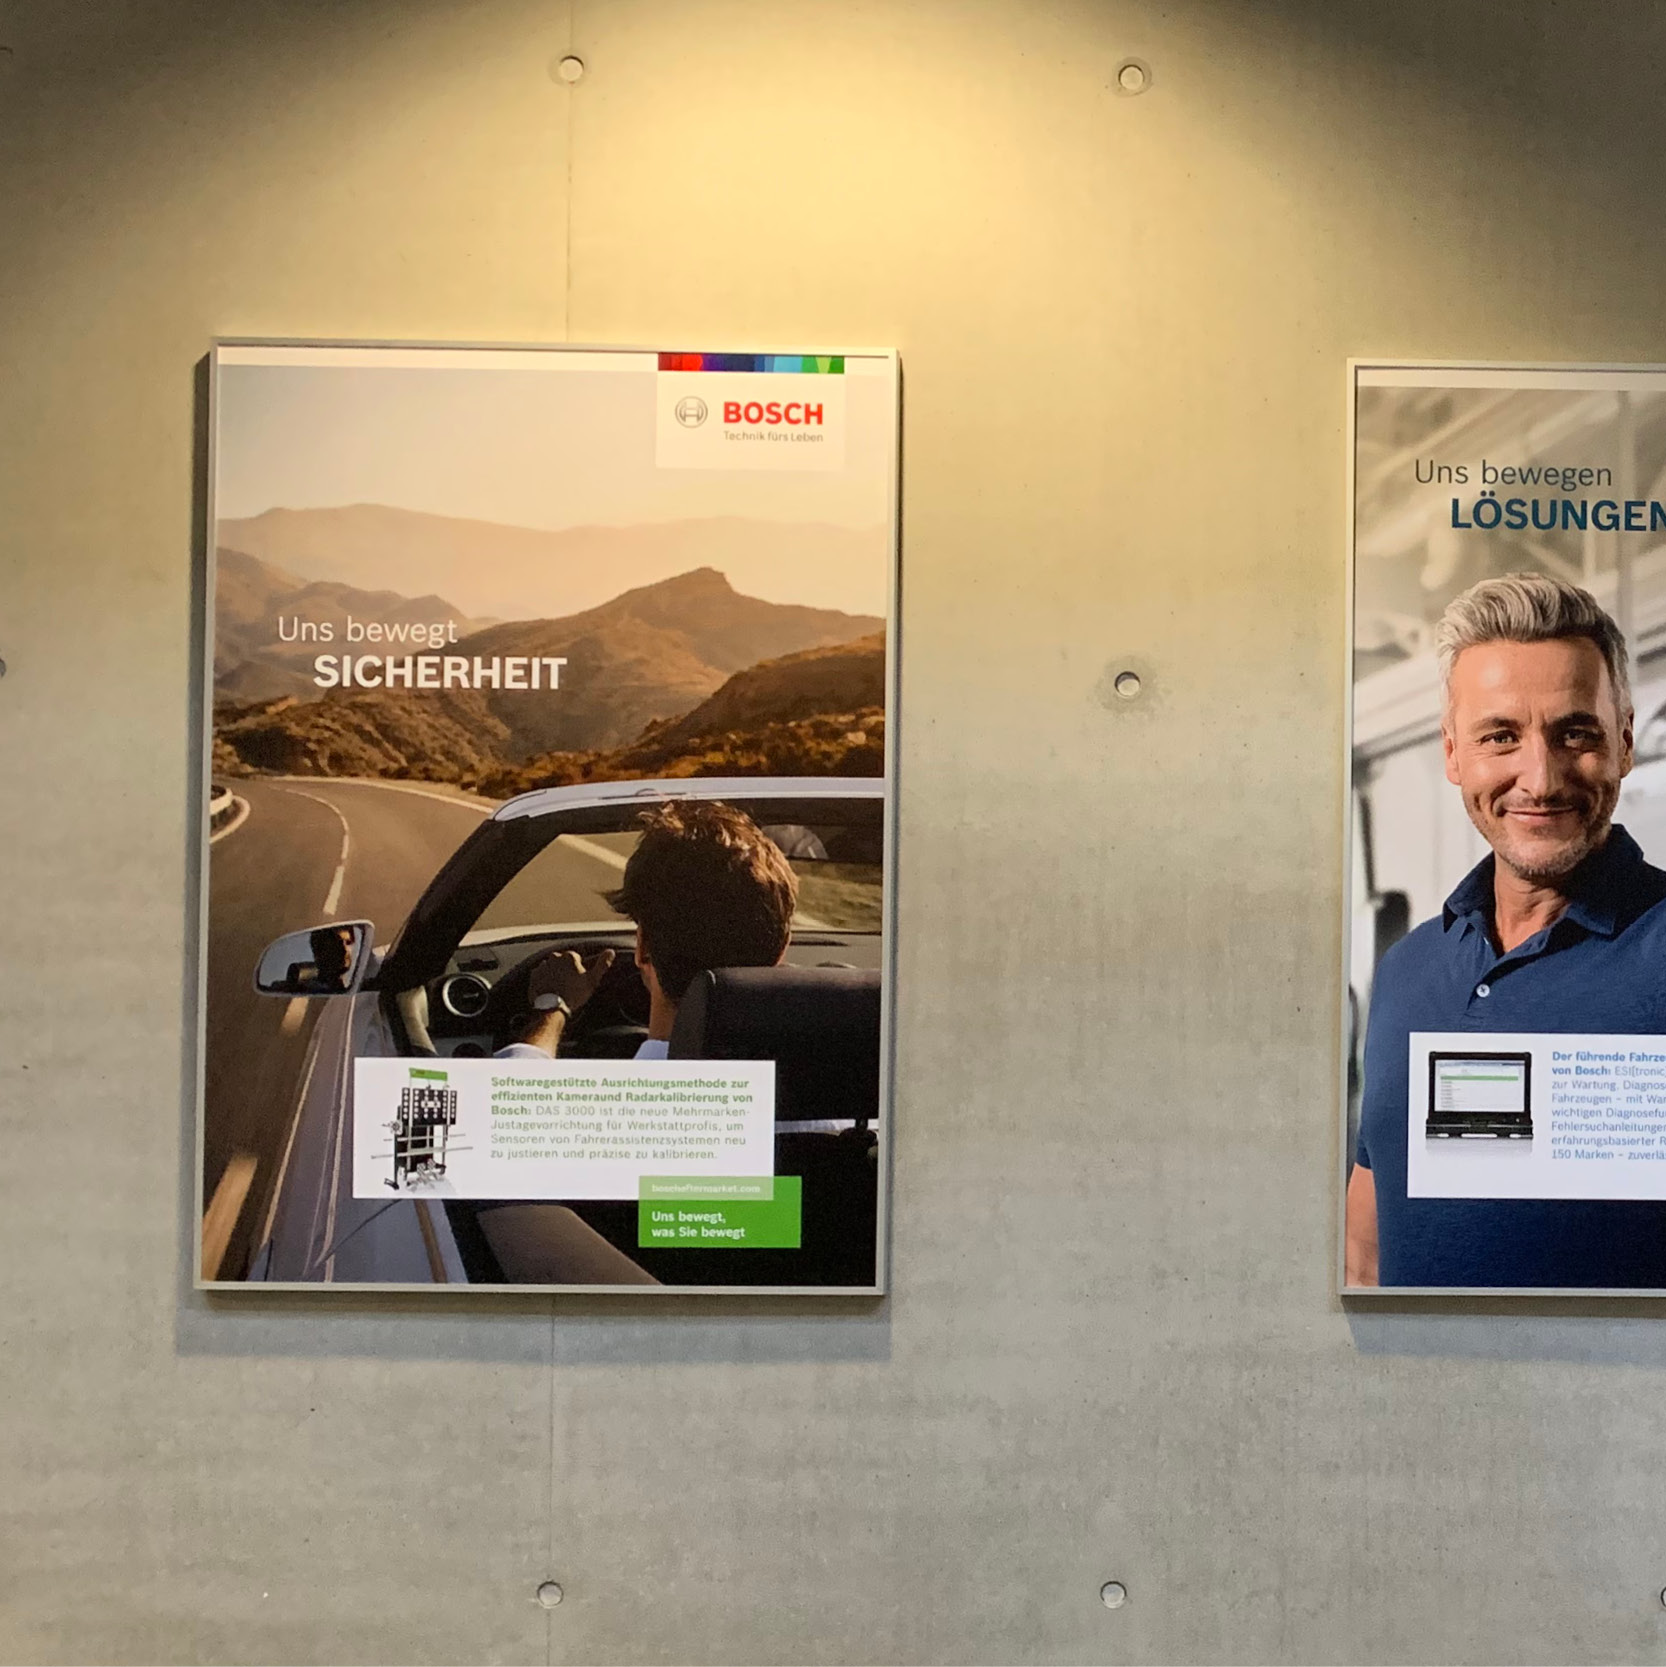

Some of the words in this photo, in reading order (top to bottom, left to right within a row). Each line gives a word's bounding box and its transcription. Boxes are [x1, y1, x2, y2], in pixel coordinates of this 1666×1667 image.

[724, 401, 822, 425] BOSCH
[724, 430, 764, 441] Technik
[767, 431, 788, 441] fürs
[790, 432, 823, 442] Leben
[1415, 459, 1469, 485] Uns
[1481, 461, 1612, 492] bewegen
[277, 617, 333, 642] Uns
[346, 615, 458, 648] bewegt
[312, 654, 568, 691] SICHERHEIT
[1552, 1051, 1571, 1060] Der
[1575, 1051, 1625, 1061] führende
[491, 1076, 596, 1089] Softwaregestützte
[601, 1077, 726, 1089] Ausrichtungsmethode
[731, 1080, 749, 1088] zur
[1551, 1081, 1567, 1089] zur
[491, 1091, 552, 1101] effizienten
[625, 1092, 728, 1104] Radarkalibrierung
[1551, 1093, 1611, 1105] Fahrzeugen
[1625, 1095, 1642, 1103] mit
[536, 1105, 559, 1115] DAS
[566, 1105, 594, 1116] 3000
[599, 1107, 612, 1115] ist
[618, 1107, 635, 1116] die
[640, 1108, 667, 1116] neue
[1551, 1108, 1601, 1119] wichtigen
[492, 1120, 602, 1132] Justagevorrichtung
[606, 1120, 621, 1130] für
[726, 1123, 743, 1131] um
[491, 1134, 544, 1143] Sensoren
[574, 1134, 720, 1145] Fahrerassistenzsystemen
[725, 1137, 746, 1145] neu
[1551, 1135, 1655, 1147] erfahrungsbasierter
[490, 1150, 503, 1158] zu
[507, 1149, 558, 1159] justieren
[562, 1149, 584, 1158] und
[589, 1150, 630, 1159] präzise
[635, 1150, 647, 1159] zu
[1552, 1149, 1571, 1159] 150
[1574, 1149, 1614, 1159] Marken
[652, 1211, 674, 1221] Uns
[652, 1228, 674, 1237] was
[679, 1226, 697, 1237] Sie
[701, 1226, 744, 1241] bewegt
